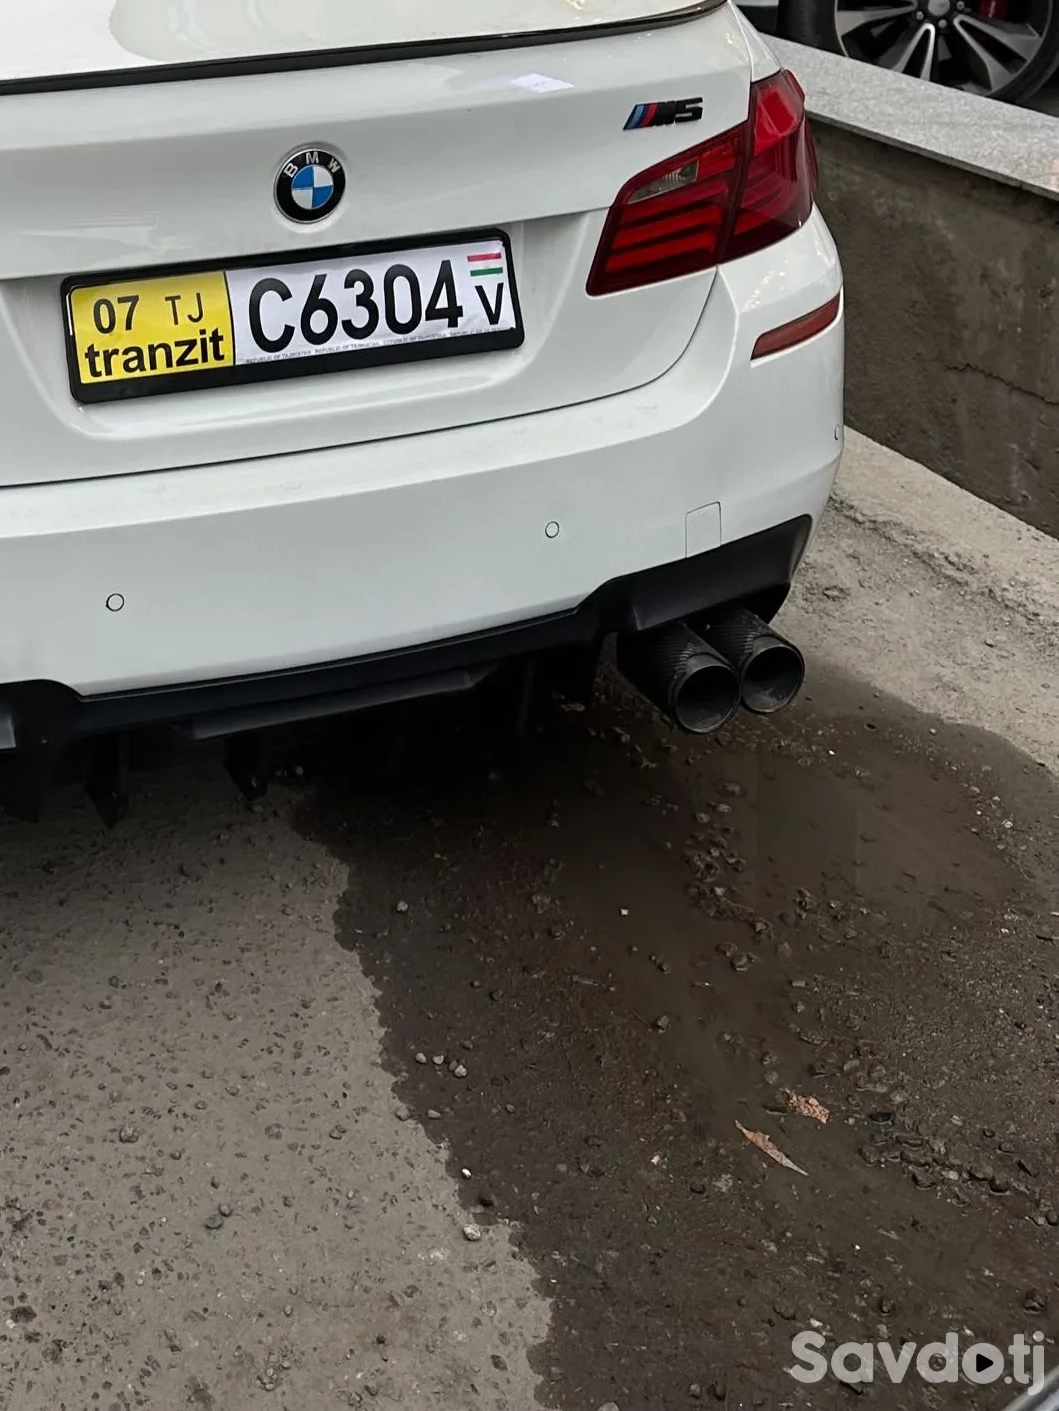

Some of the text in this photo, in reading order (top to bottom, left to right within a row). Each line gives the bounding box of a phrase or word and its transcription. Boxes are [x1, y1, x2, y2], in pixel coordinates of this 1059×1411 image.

[283, 151, 341, 178] BMW
[93, 292, 204, 335] 07 TJ
[248, 259, 505, 353] C6304 V
[84, 327, 225, 379] tranzit
